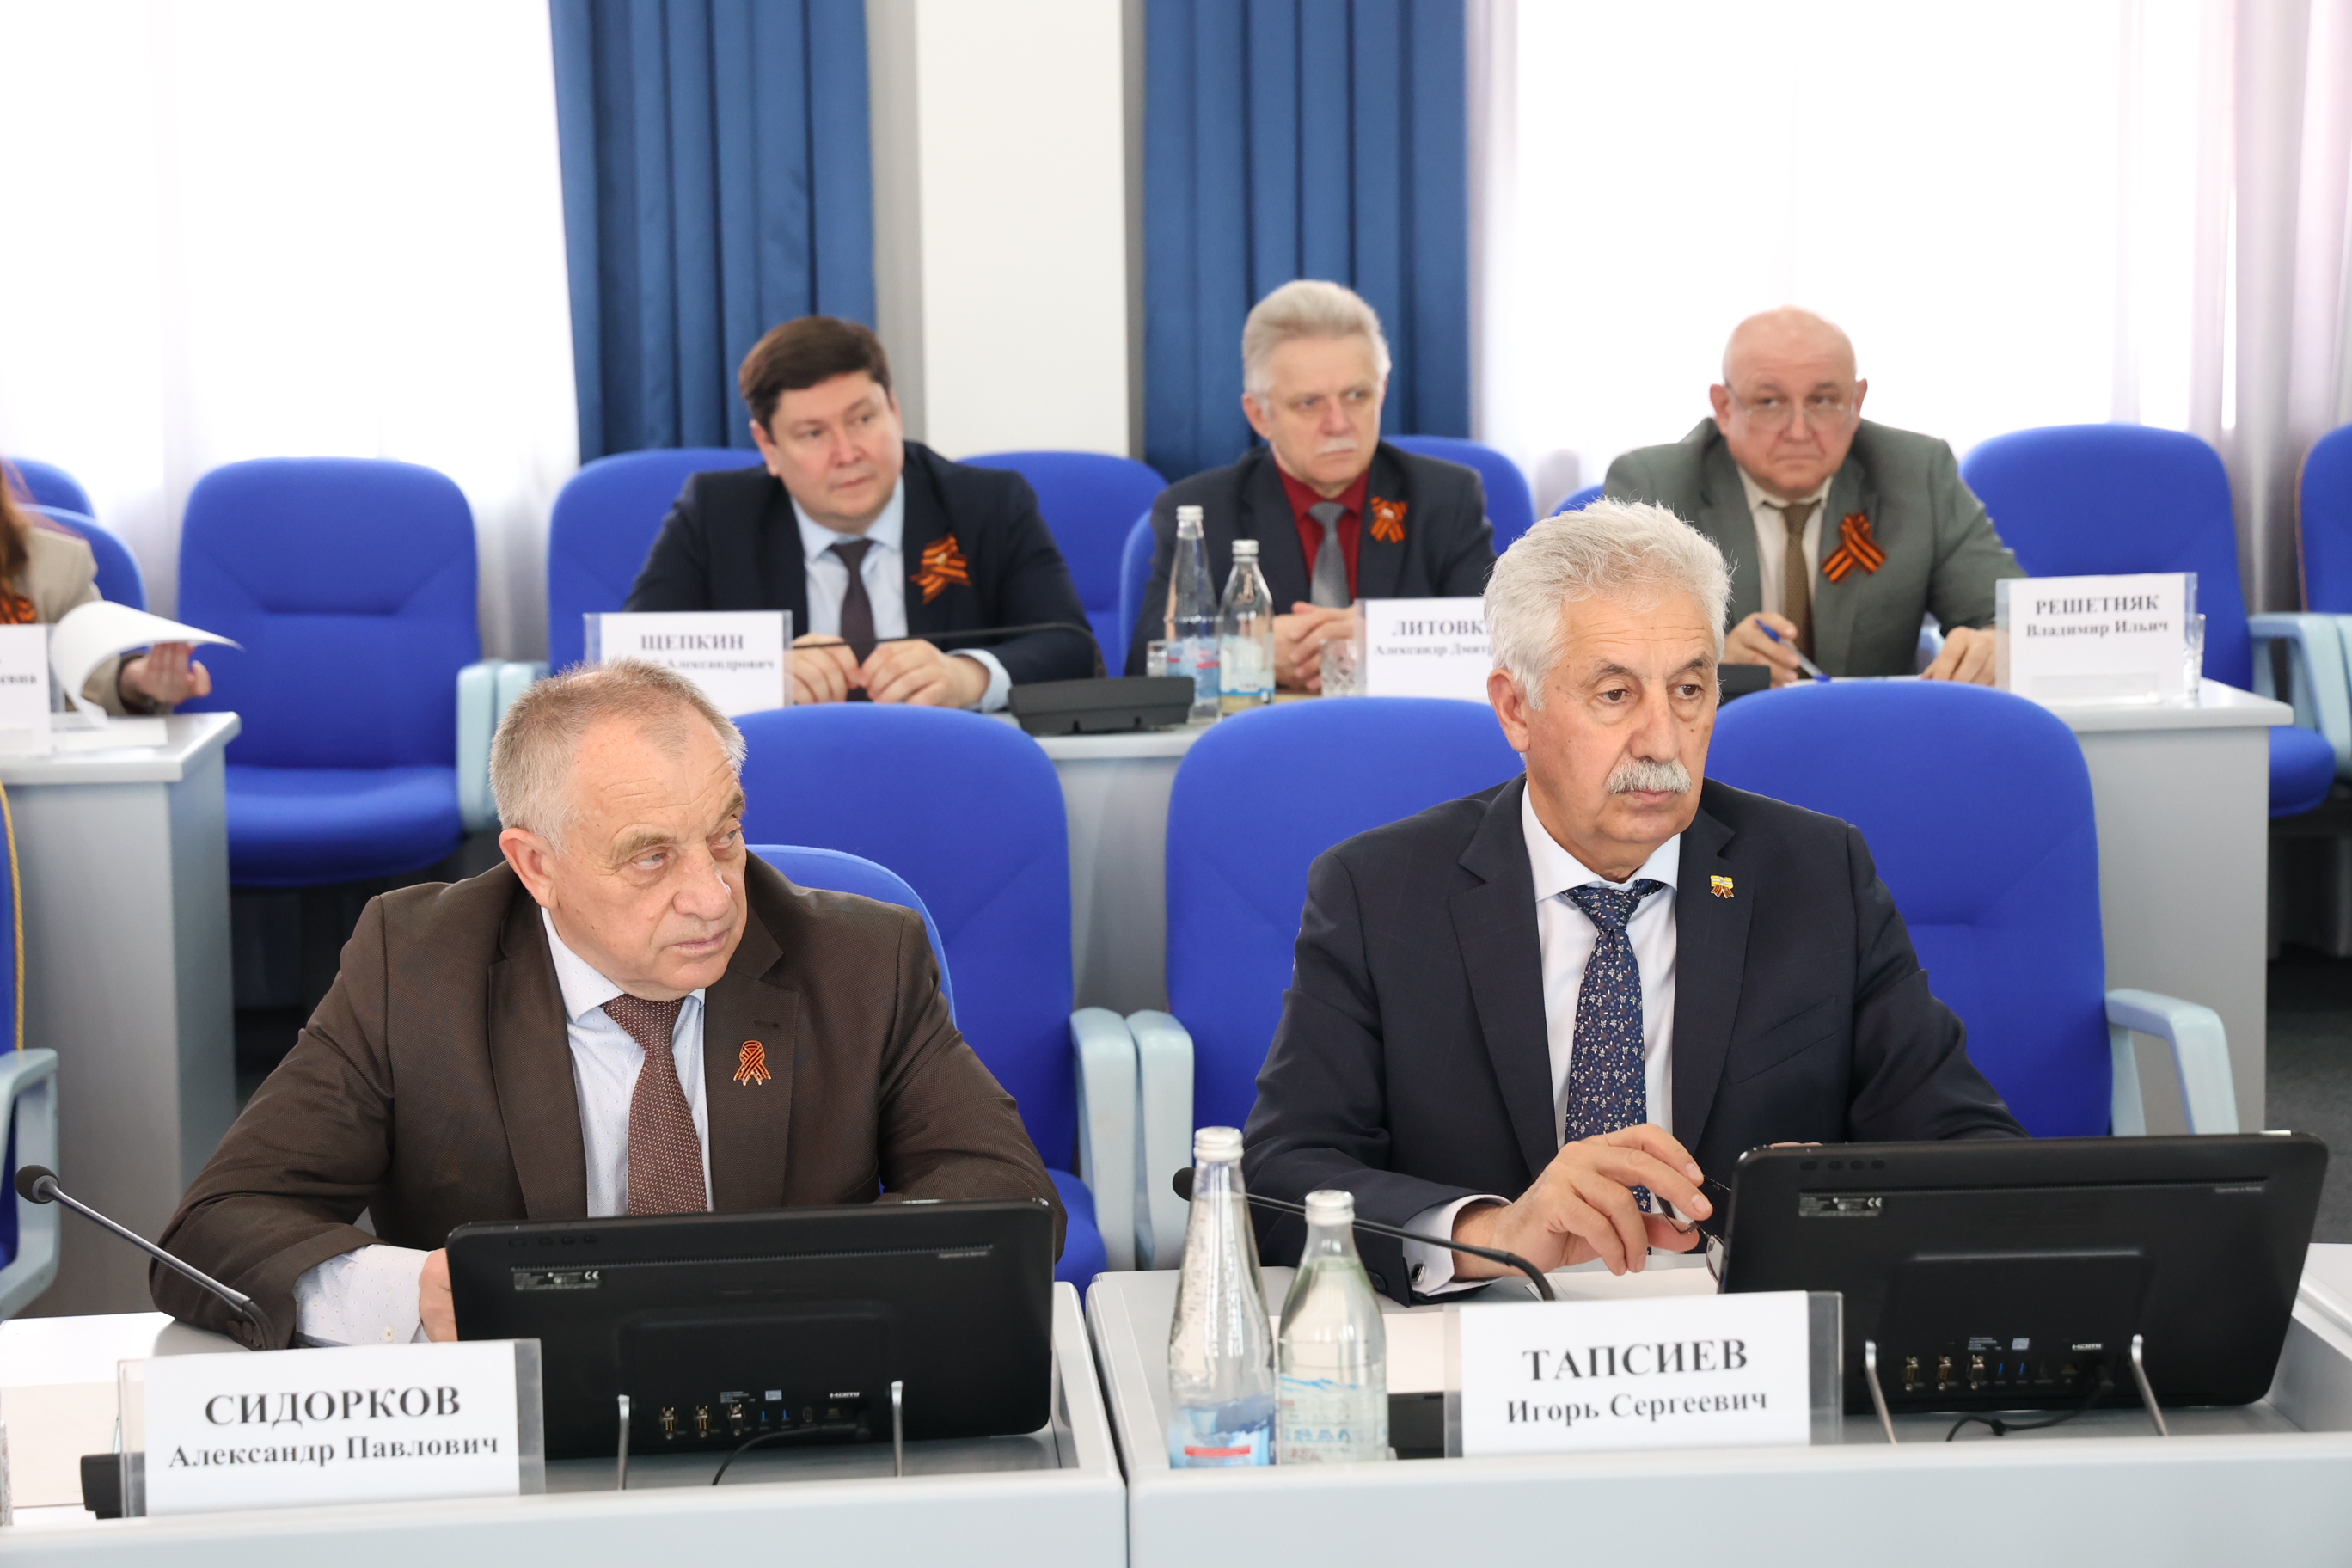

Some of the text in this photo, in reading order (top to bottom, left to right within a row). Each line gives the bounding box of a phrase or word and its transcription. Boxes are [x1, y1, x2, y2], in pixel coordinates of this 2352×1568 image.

[2035, 594, 2159, 616] РЕШЕТНЯК
[1392, 619, 1487, 637] ЛИТОВК
[2026, 619, 2169, 639] Владимир Ильич
[640, 633, 744, 652] ЩЕПКИН
[1375, 644, 1448, 658] Александр
[1522, 1338, 1749, 1382] ТАПСИЕВ
[205, 1386, 462, 1430] СИДОРКОВ
[1506, 1393, 1767, 1427] Игорь Сергеевич
[168, 1436, 499, 1468] Александр Павлович
